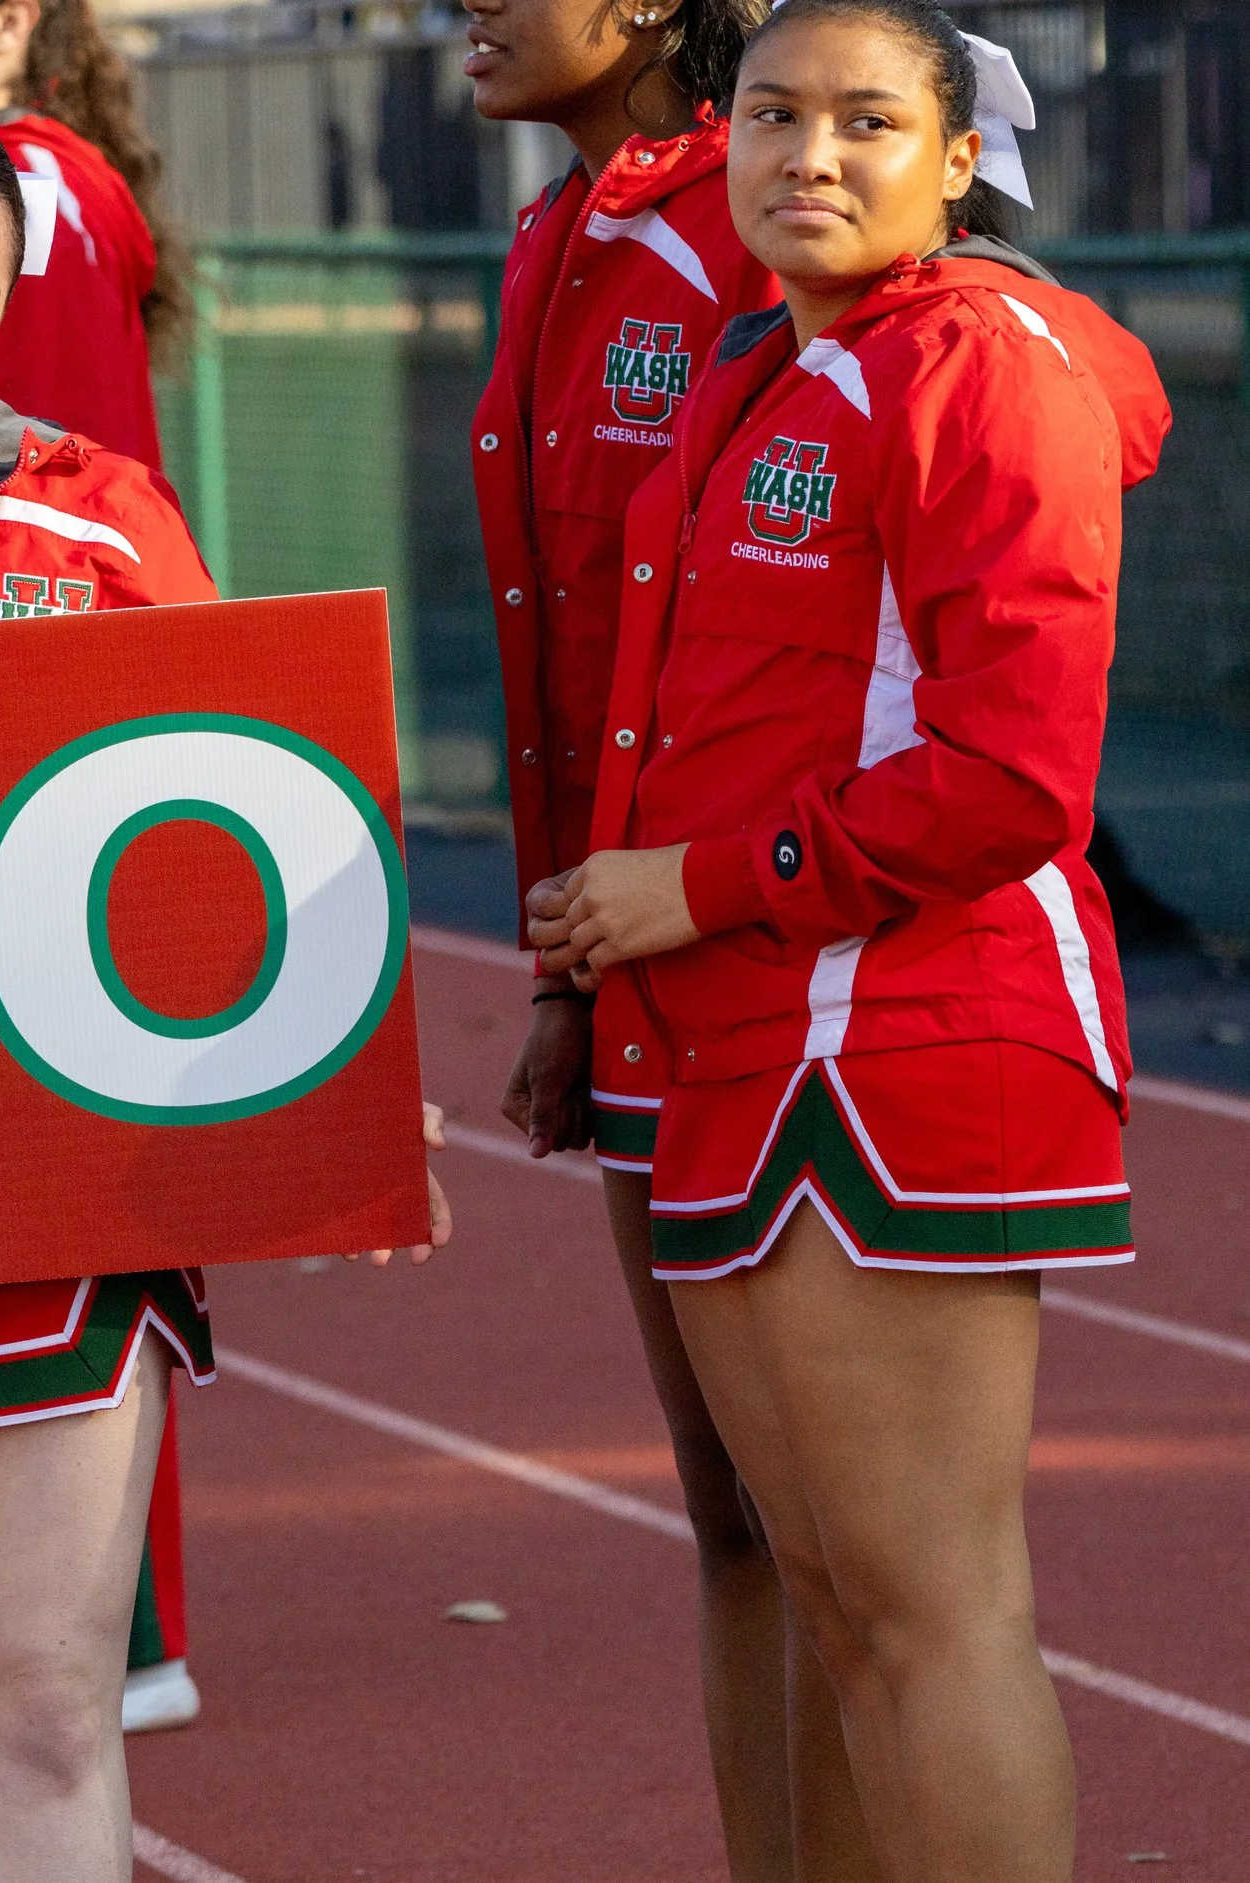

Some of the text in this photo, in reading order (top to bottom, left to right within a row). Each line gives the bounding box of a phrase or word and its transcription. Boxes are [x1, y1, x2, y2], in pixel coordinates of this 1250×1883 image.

[603, 342, 691, 398] WASH
[593, 425, 674, 448] CHEERLEADI
[742, 458, 837, 522] WASH
[731, 541, 830, 569] CHEERLEADING
